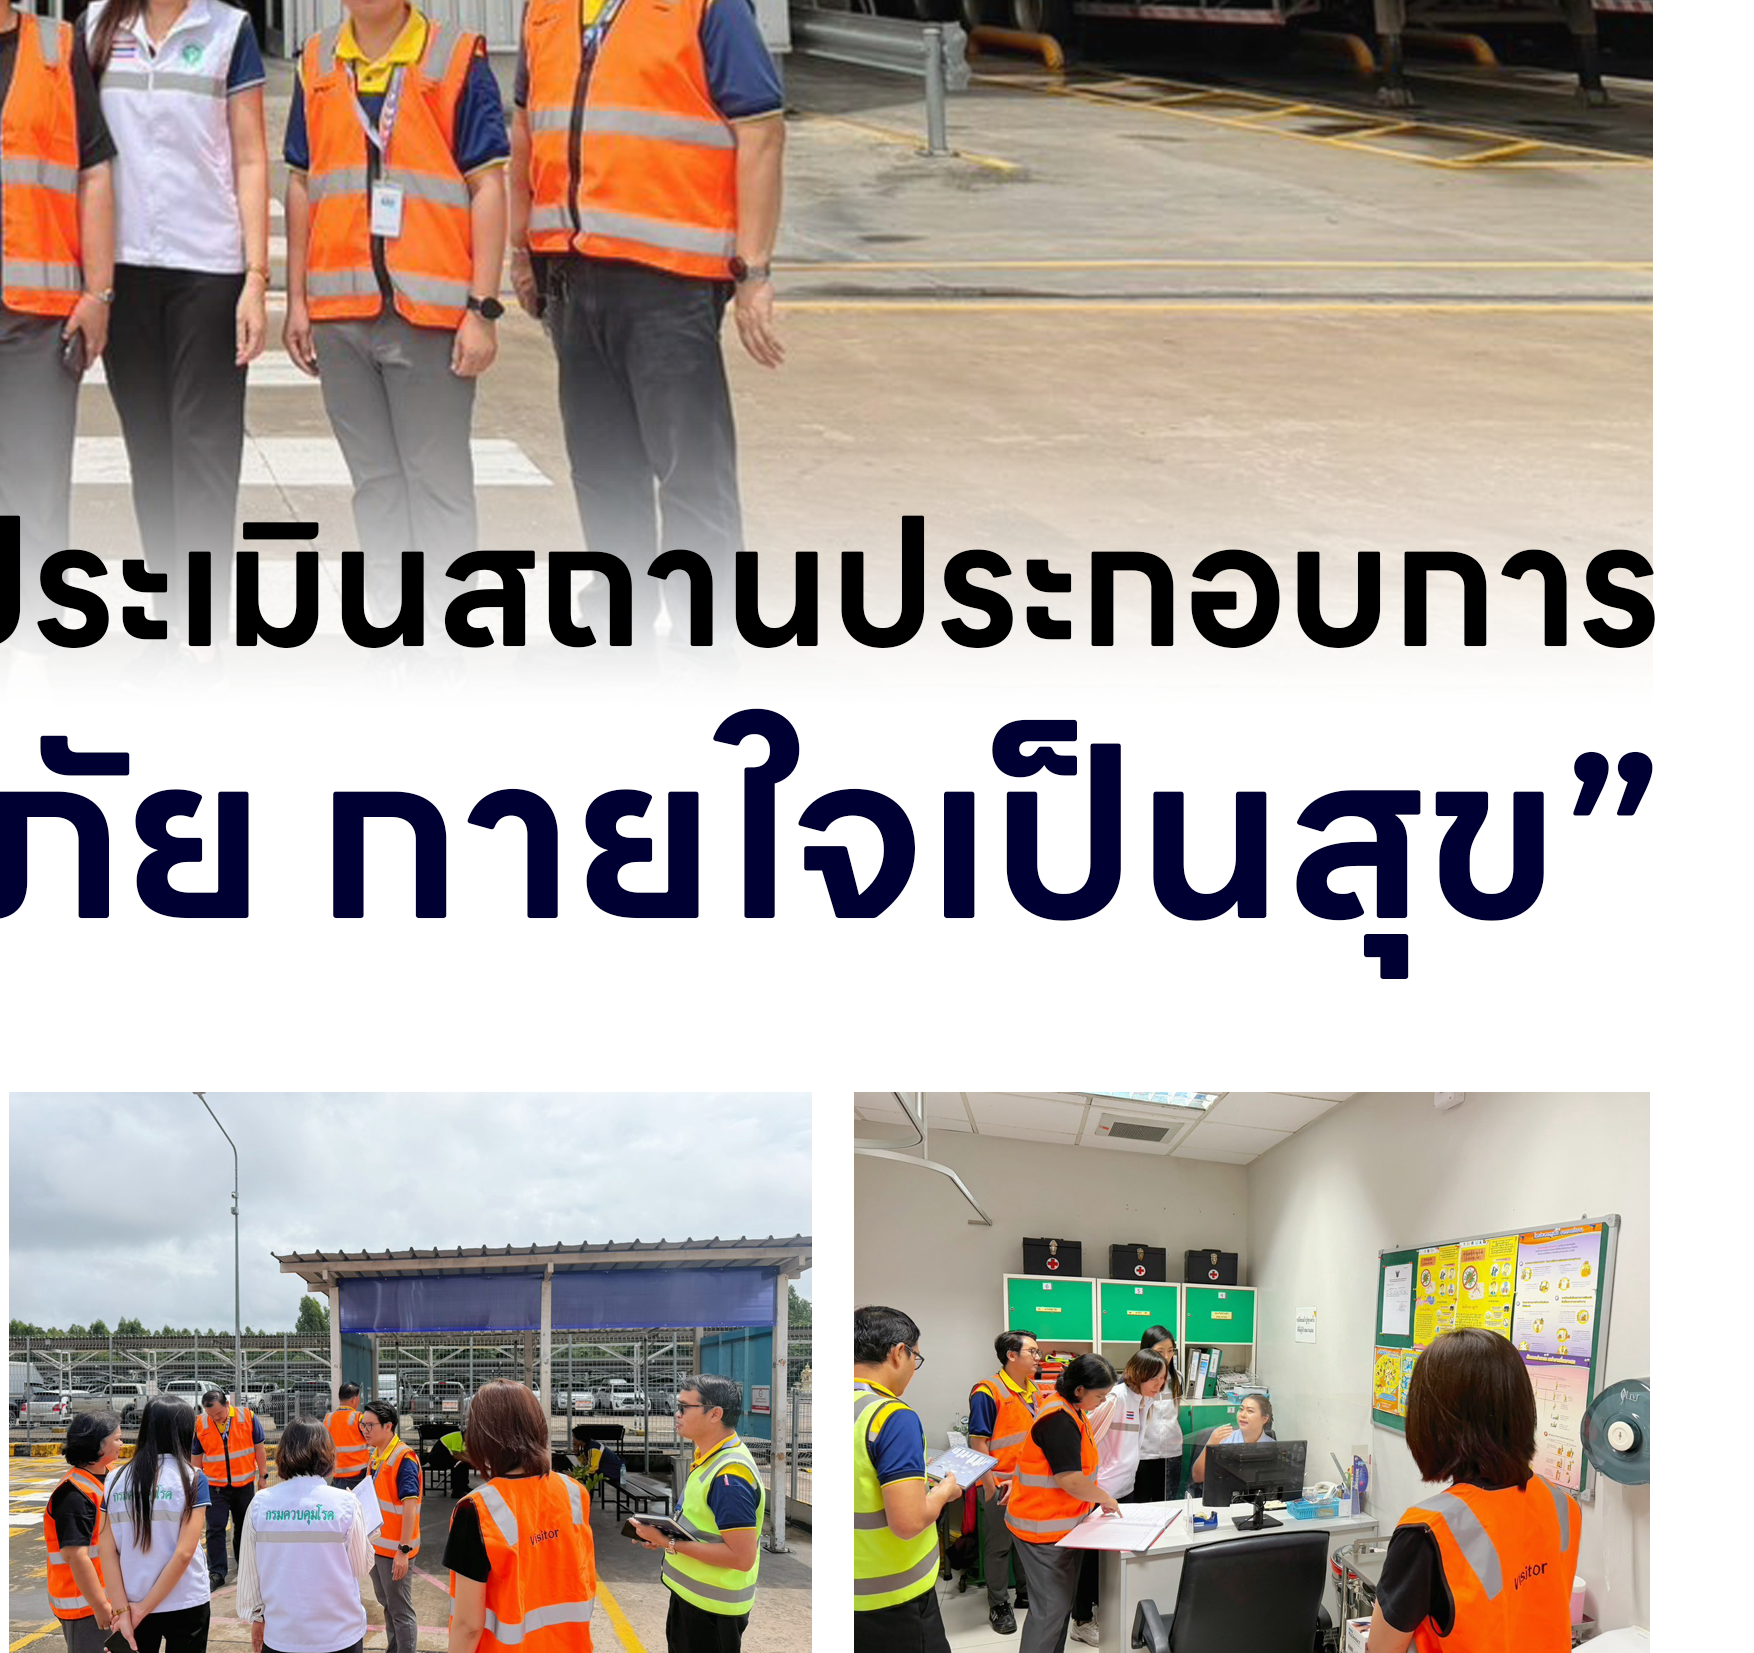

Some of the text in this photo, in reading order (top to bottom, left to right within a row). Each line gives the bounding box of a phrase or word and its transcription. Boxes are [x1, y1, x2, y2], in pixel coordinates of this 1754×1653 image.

[264, 1504, 336, 1526] กรมควบคุมโรค
[529, 1527, 560, 1546] Visitor
